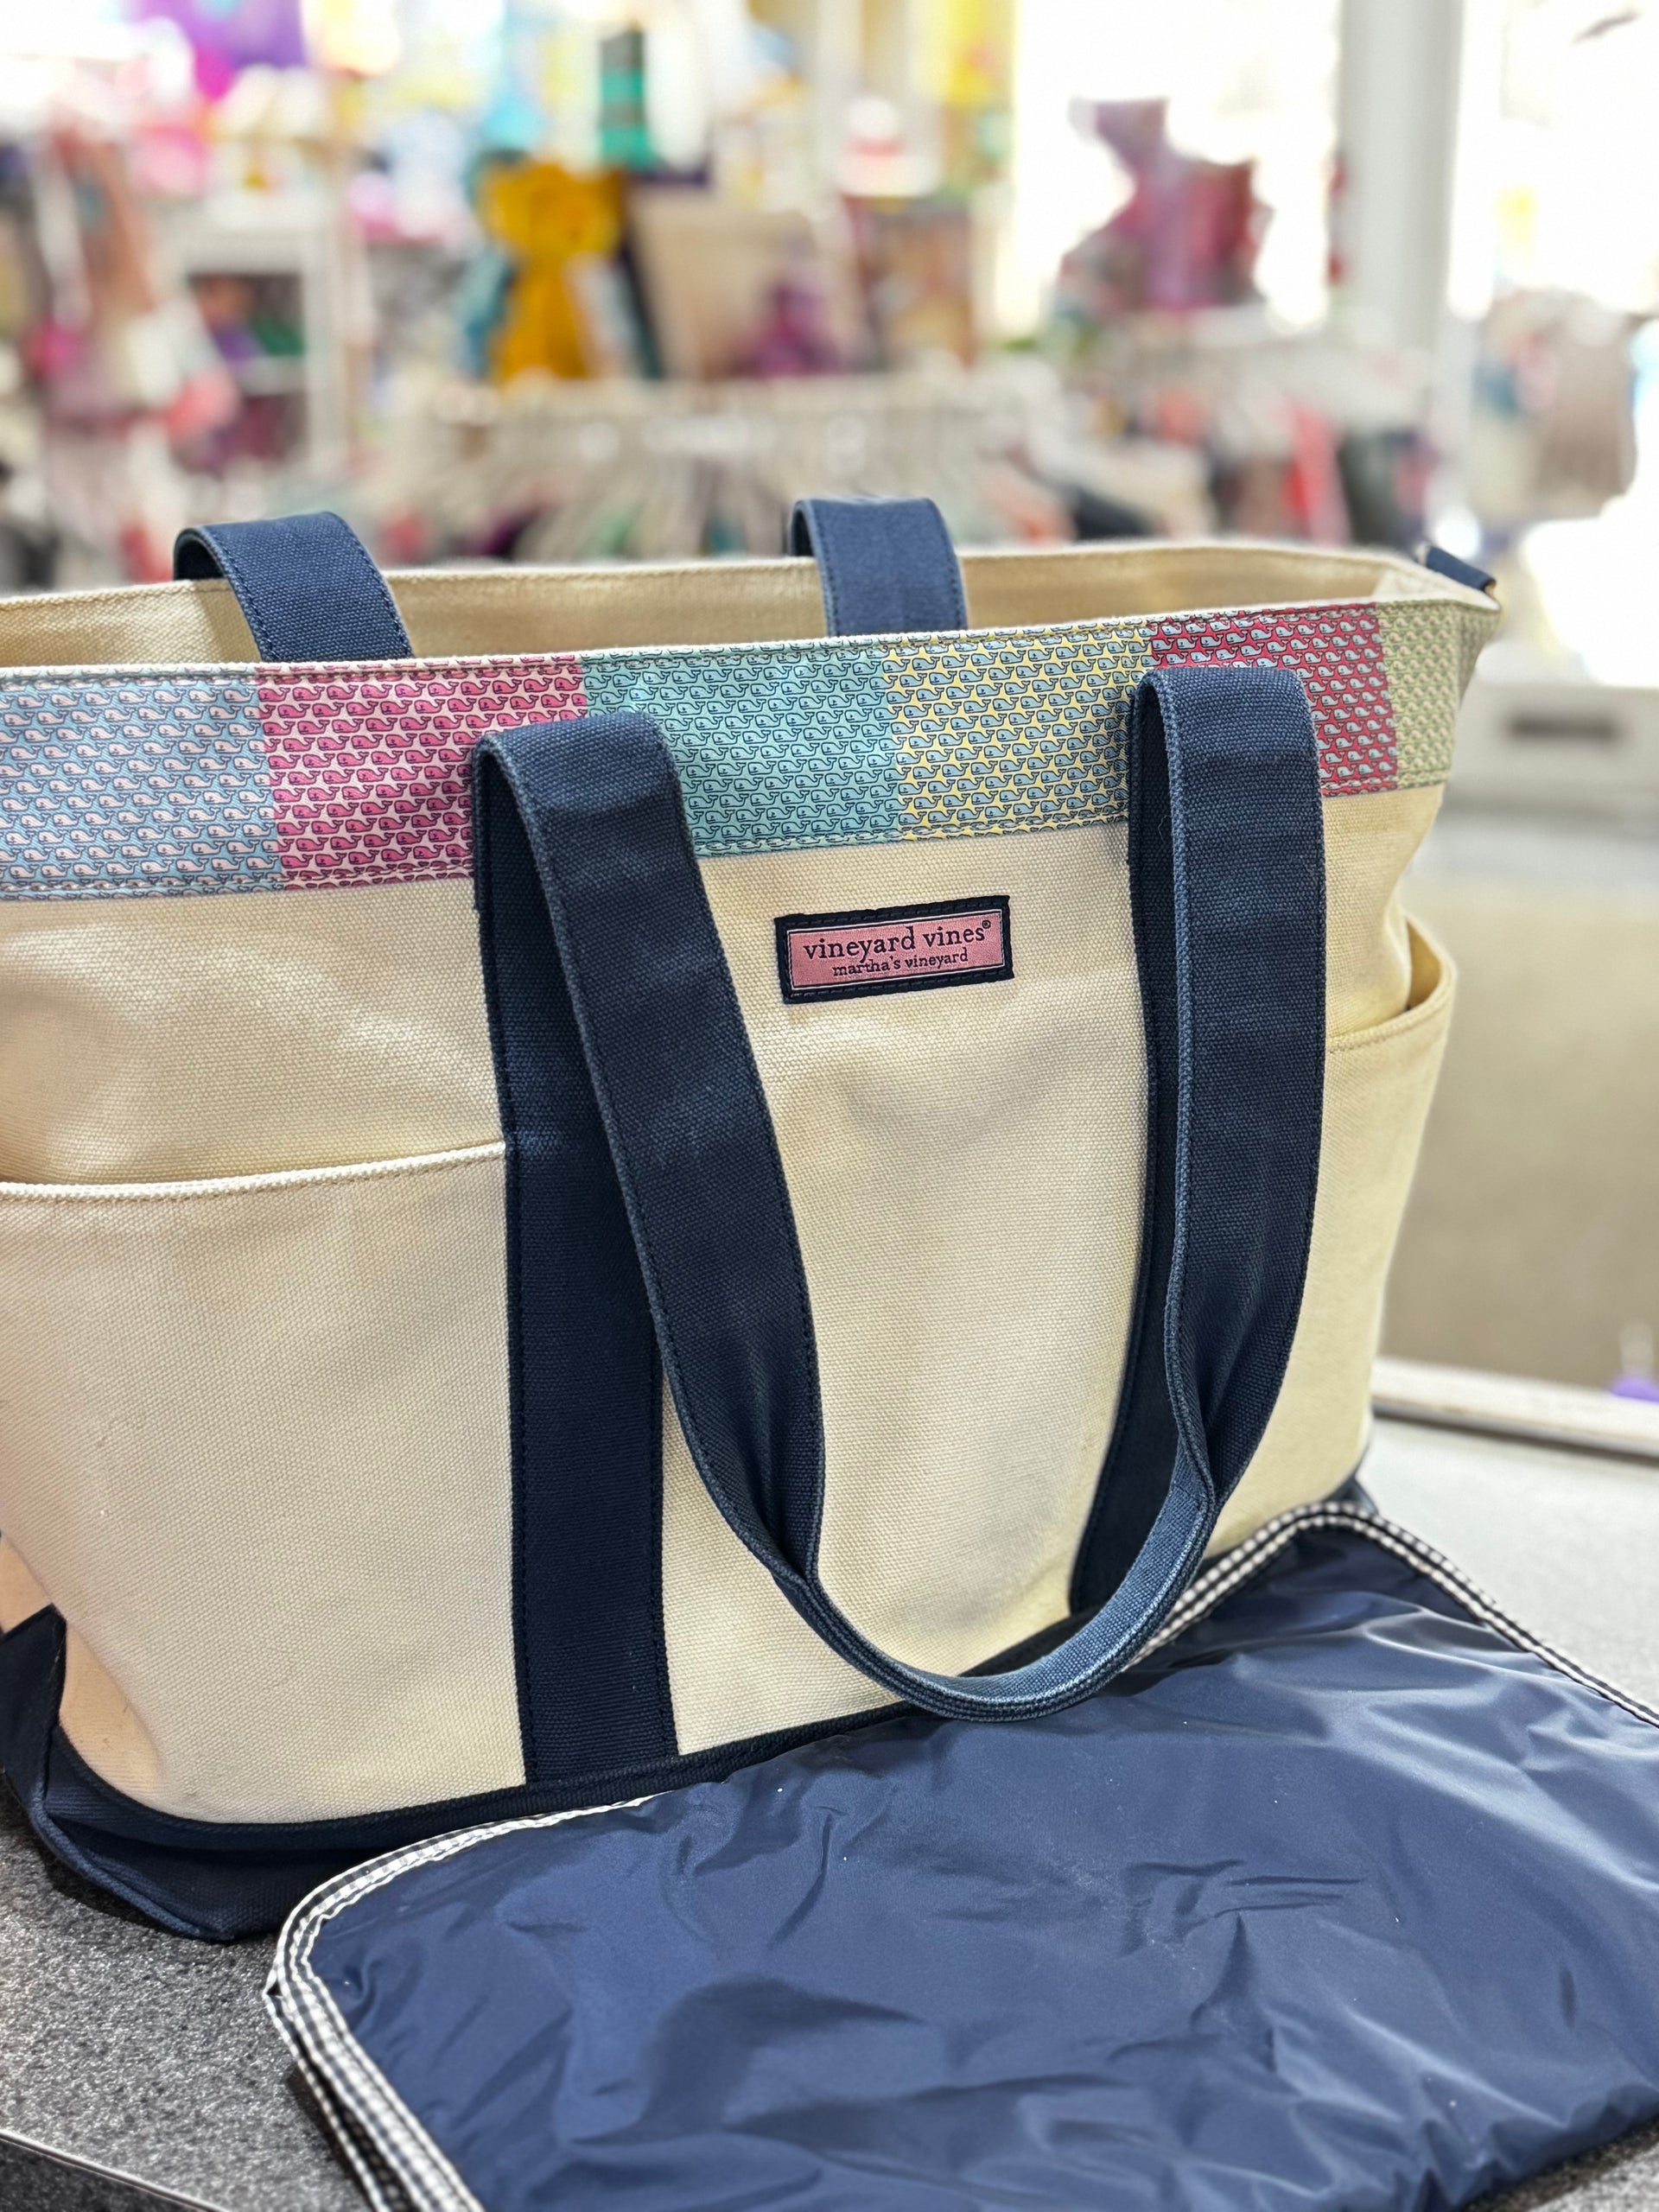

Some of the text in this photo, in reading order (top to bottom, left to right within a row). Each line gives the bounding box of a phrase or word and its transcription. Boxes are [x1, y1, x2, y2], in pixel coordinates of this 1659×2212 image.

[803, 926, 916, 963] vineyard
[832, 947, 969, 976] martha's vineyard
